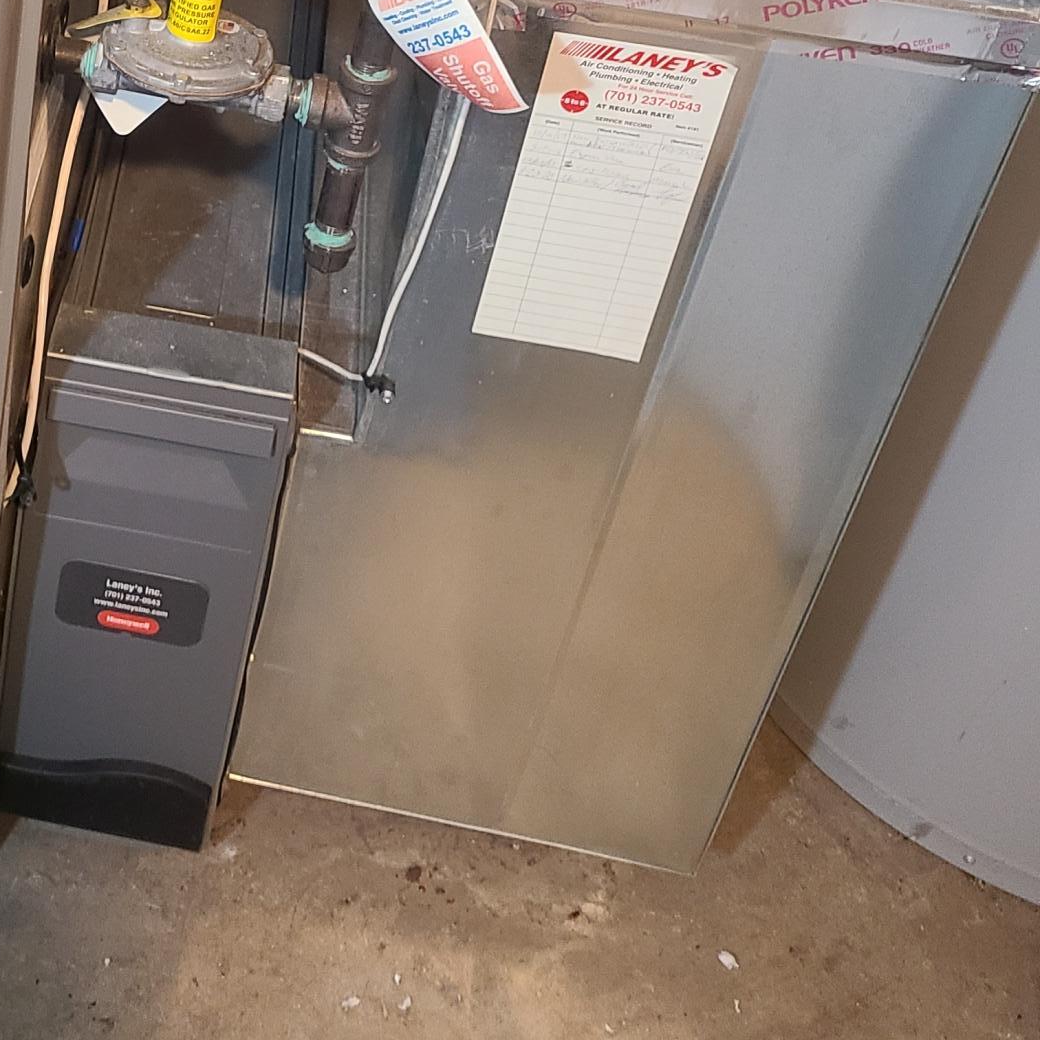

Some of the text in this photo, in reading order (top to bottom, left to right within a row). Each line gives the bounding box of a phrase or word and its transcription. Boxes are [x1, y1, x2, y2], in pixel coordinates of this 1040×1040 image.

[177, 6, 215, 18] PRESSURE
[408, 25, 472, 54] 237-0543
[580, 60, 698, 84] Air Conditioning Heating
[605, 46, 729, 78] LANEY'S
[442, 54, 494, 108] Shutoff
[473, 60, 499, 94] Gas
[589, 70, 684, 90] Plumbing Electrical
[604, 90, 638, 104] (701)
[641, 95, 701, 112] 237-0543
[608, 104, 648, 116] REGULAR
[650, 111, 674, 120] RATE!
[595, 116, 652, 129] SERVICE RECORD
[104, 590, 161, 606] (701) 237-0543
[106, 578, 162, 598] Laney's Inc.
[94, 598, 168, 618] www.laneysinc.com
[106, 615, 150, 630] Honeywell
